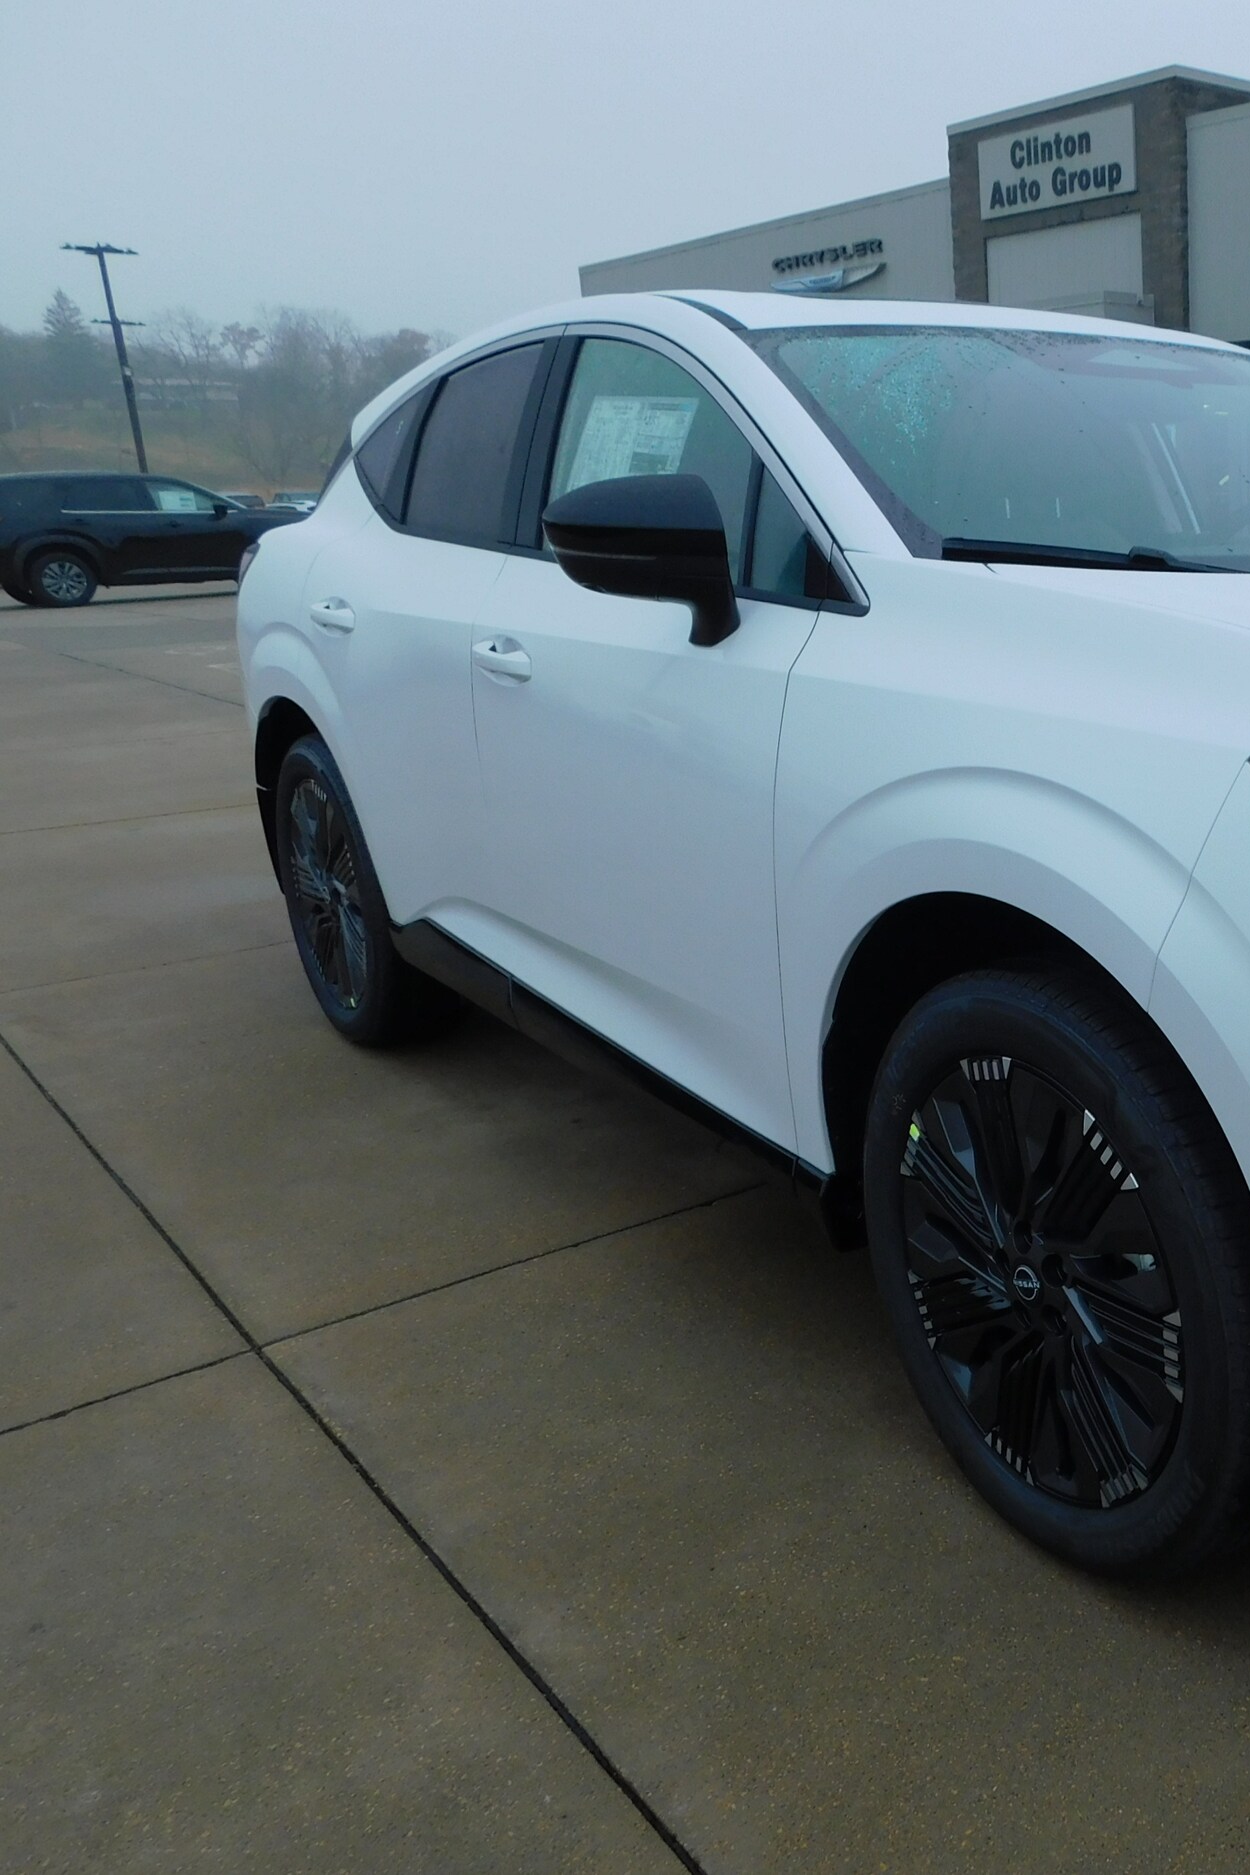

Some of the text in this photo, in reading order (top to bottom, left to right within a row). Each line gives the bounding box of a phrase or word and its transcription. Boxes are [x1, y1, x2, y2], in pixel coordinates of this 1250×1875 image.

[1010, 130, 1091, 170] Clinton
[989, 161, 1122, 210] Auto Group
[772, 238, 883, 273] CHRYSLER
